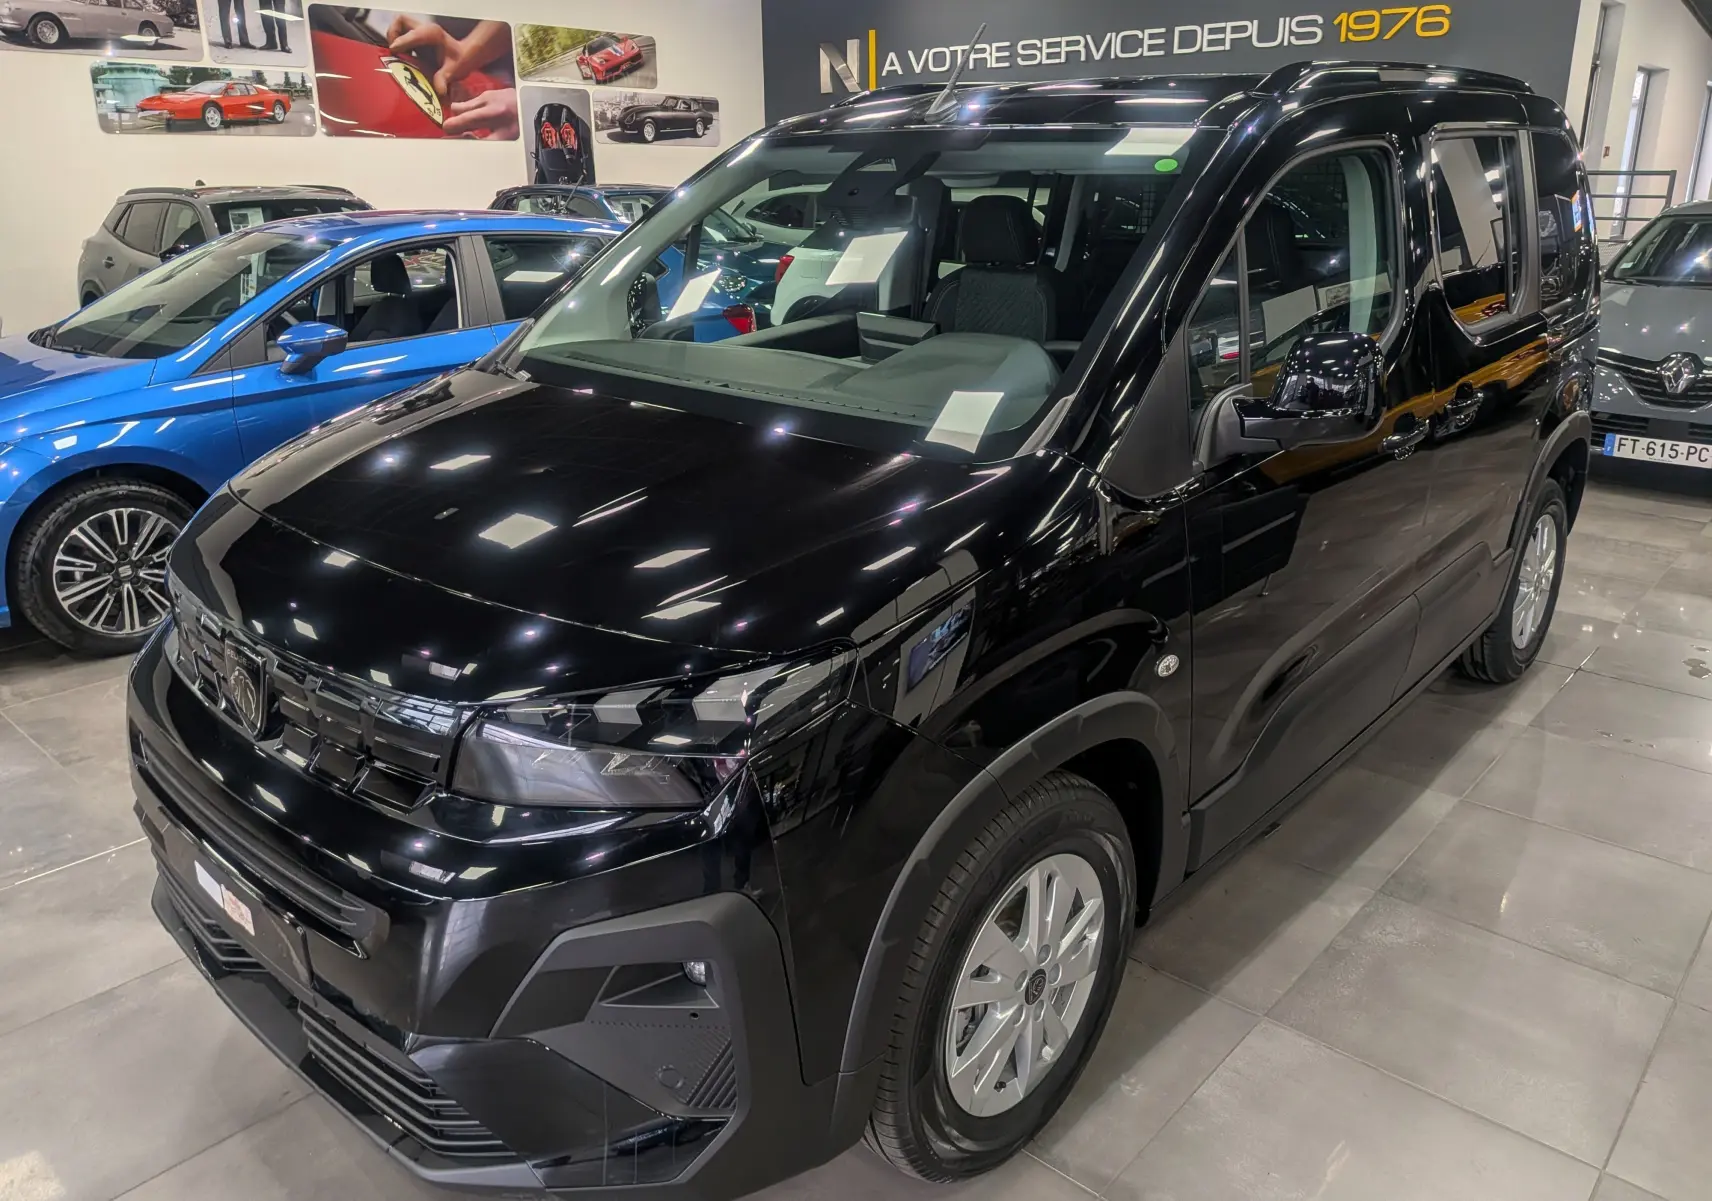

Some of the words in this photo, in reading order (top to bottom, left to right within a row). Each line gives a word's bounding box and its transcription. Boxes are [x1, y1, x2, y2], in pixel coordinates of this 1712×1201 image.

[882, 52, 903, 76] A
[908, 41, 1011, 74] VOTRE
[1017, 28, 1166, 66] SERVICE
[1173, 15, 1324, 54] DEPUIS
[1333, 4, 1452, 43] 1976
[1617, 437, 1710, 463] FT-615-PC
